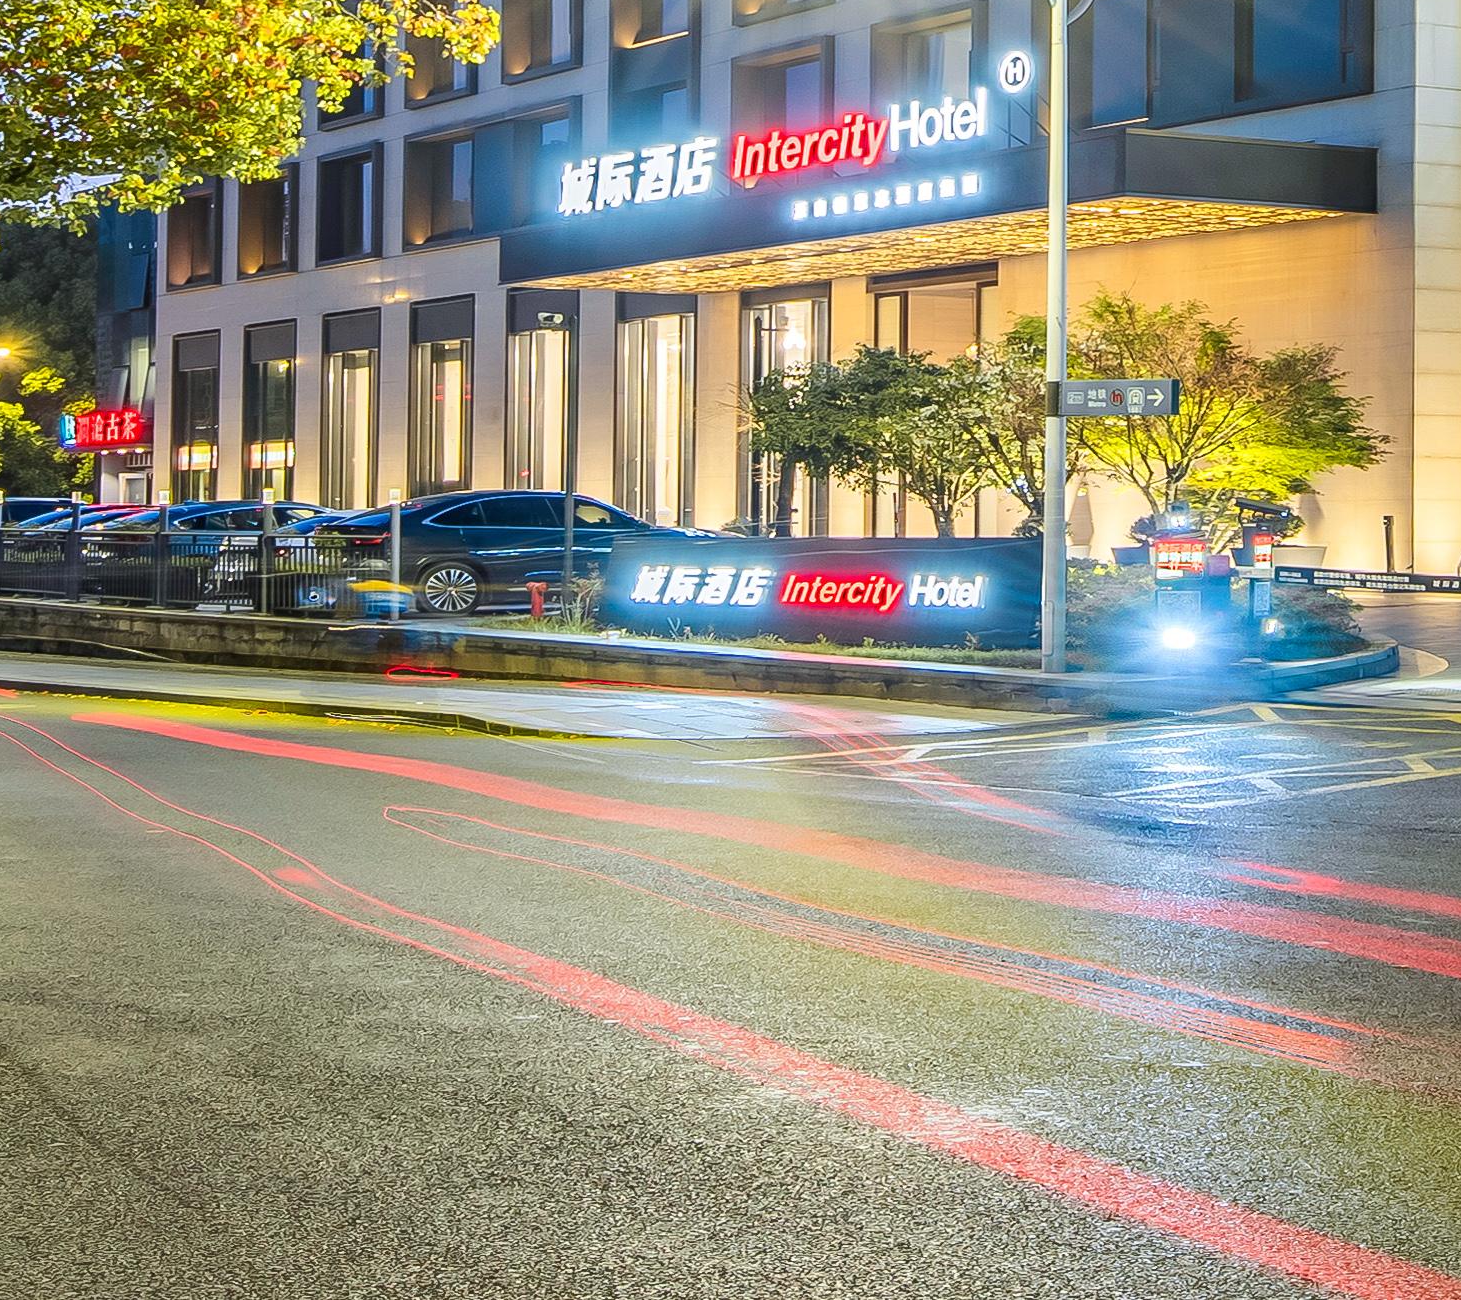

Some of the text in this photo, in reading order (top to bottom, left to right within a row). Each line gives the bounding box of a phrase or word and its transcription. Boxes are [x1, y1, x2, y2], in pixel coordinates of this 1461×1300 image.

[557, 135, 719, 218] 城际酒店
[630, 564, 985, 613] 城际酒店 Intercity Hotel
